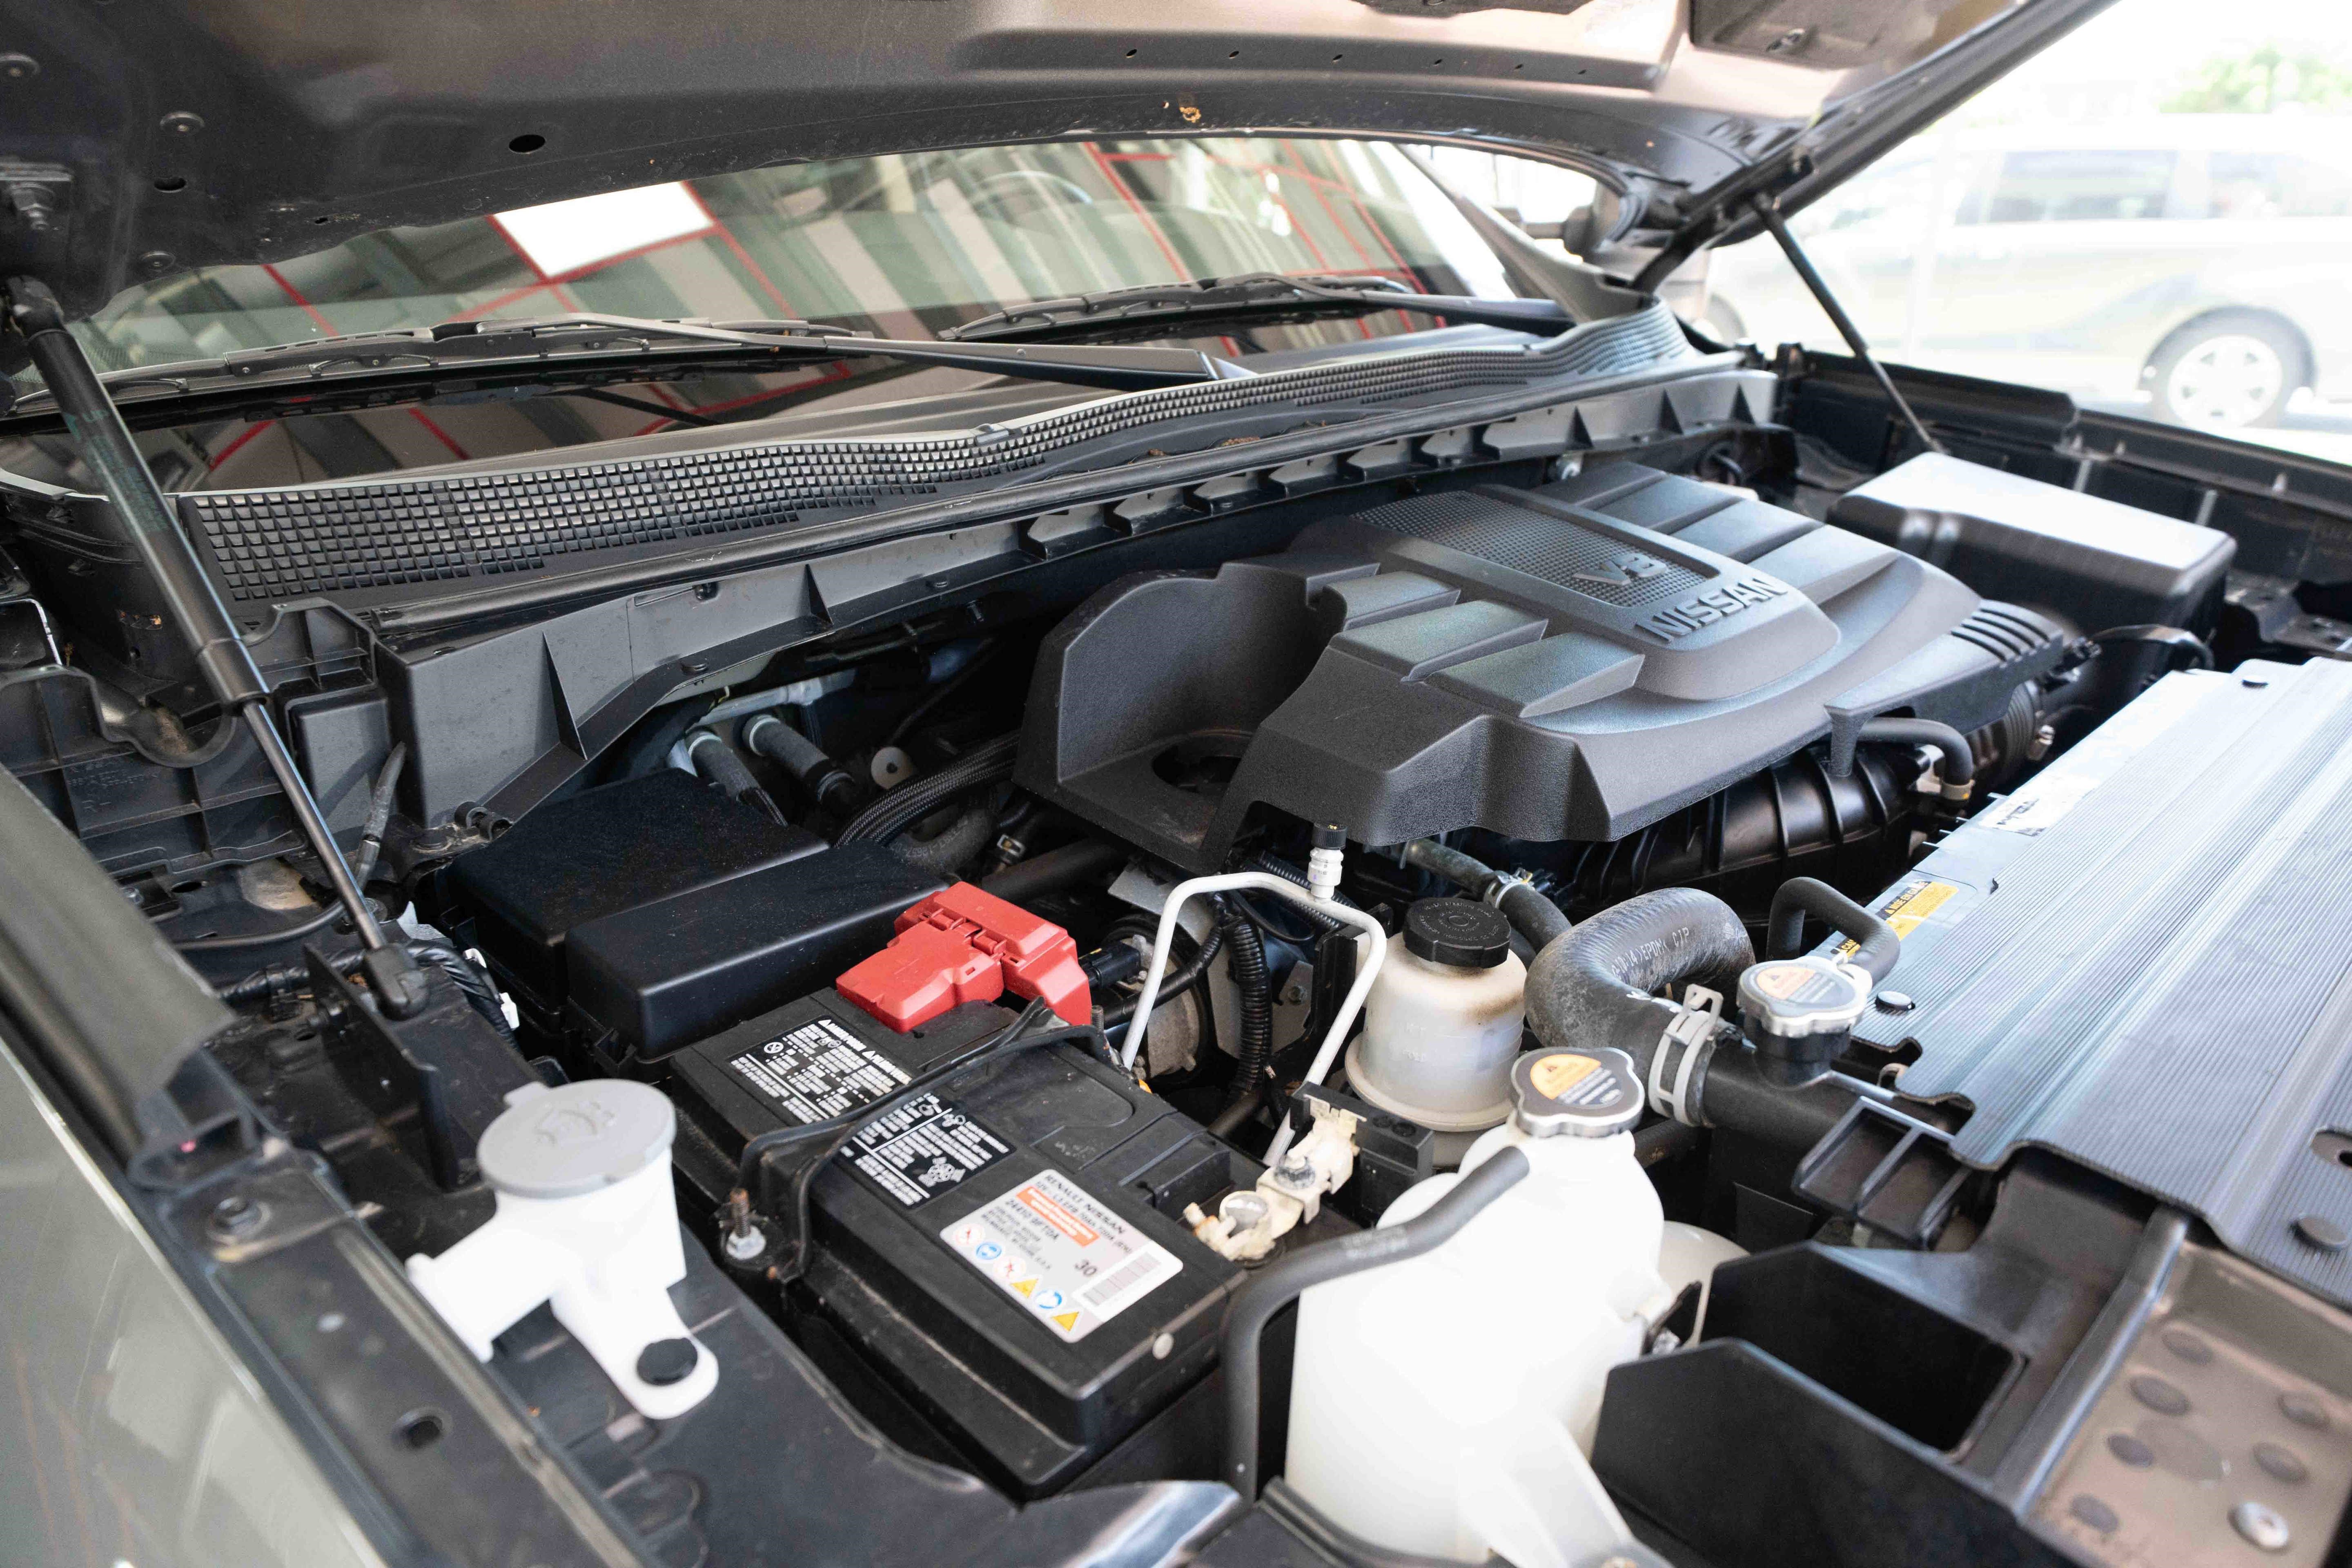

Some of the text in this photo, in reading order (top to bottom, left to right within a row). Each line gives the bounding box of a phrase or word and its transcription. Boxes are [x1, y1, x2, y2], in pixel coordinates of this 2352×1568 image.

[1571, 552, 1667, 587] V8
[1635, 578, 1788, 643] NISSAN
[1045, 1174, 1126, 1234] RENAULT NISSAN
[1074, 1259, 1098, 1276] 30
